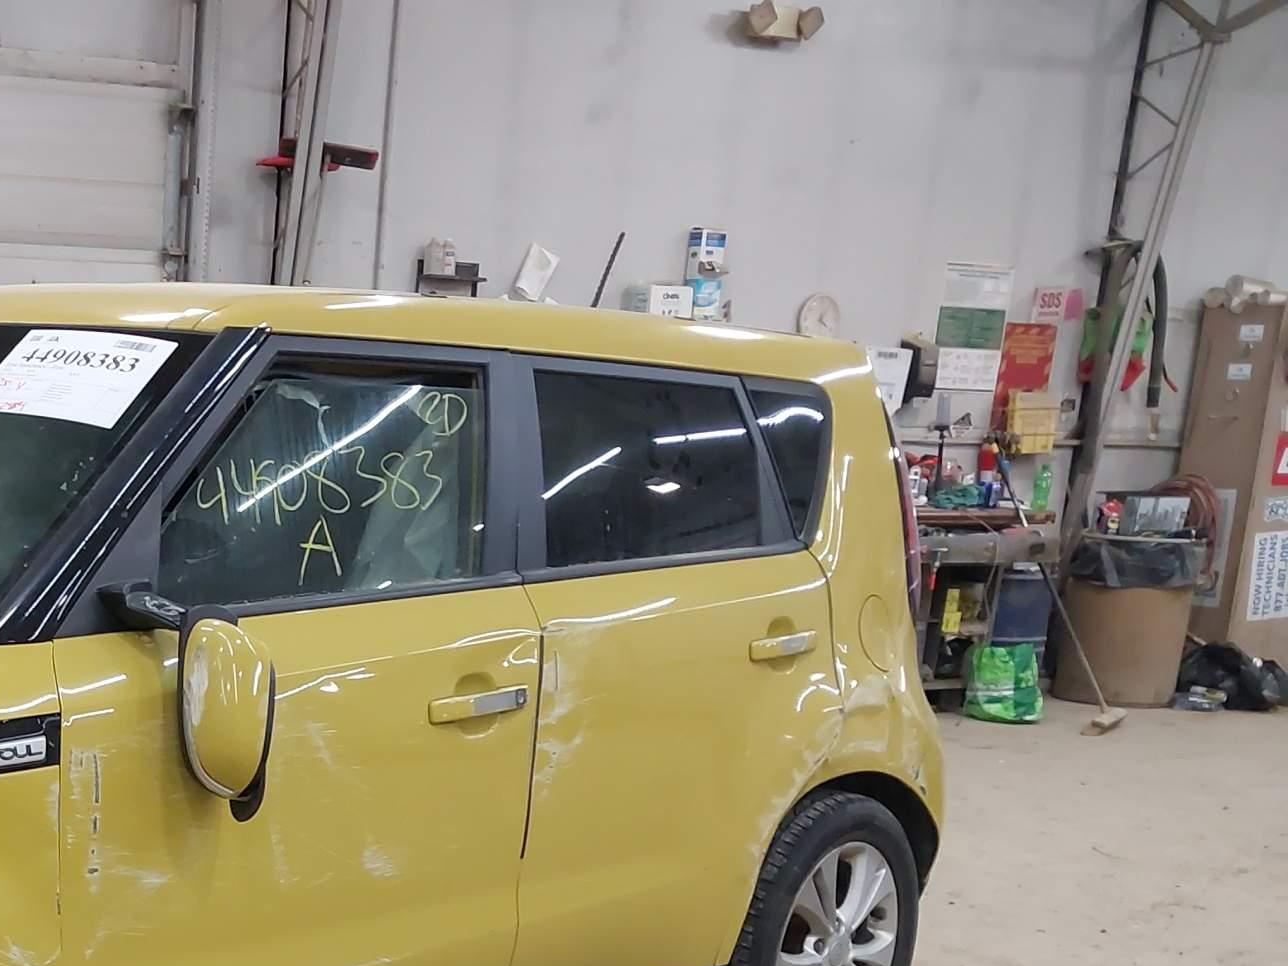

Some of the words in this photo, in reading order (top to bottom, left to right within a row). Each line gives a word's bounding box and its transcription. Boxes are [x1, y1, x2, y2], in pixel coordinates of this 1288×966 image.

[20, 347, 141, 373] 44908383
[196, 445, 443, 526] 44908383
[299, 515, 344, 586] A
[1262, 534, 1278, 617] TECHNICIANS
[1252, 584, 1262, 616] NOW
